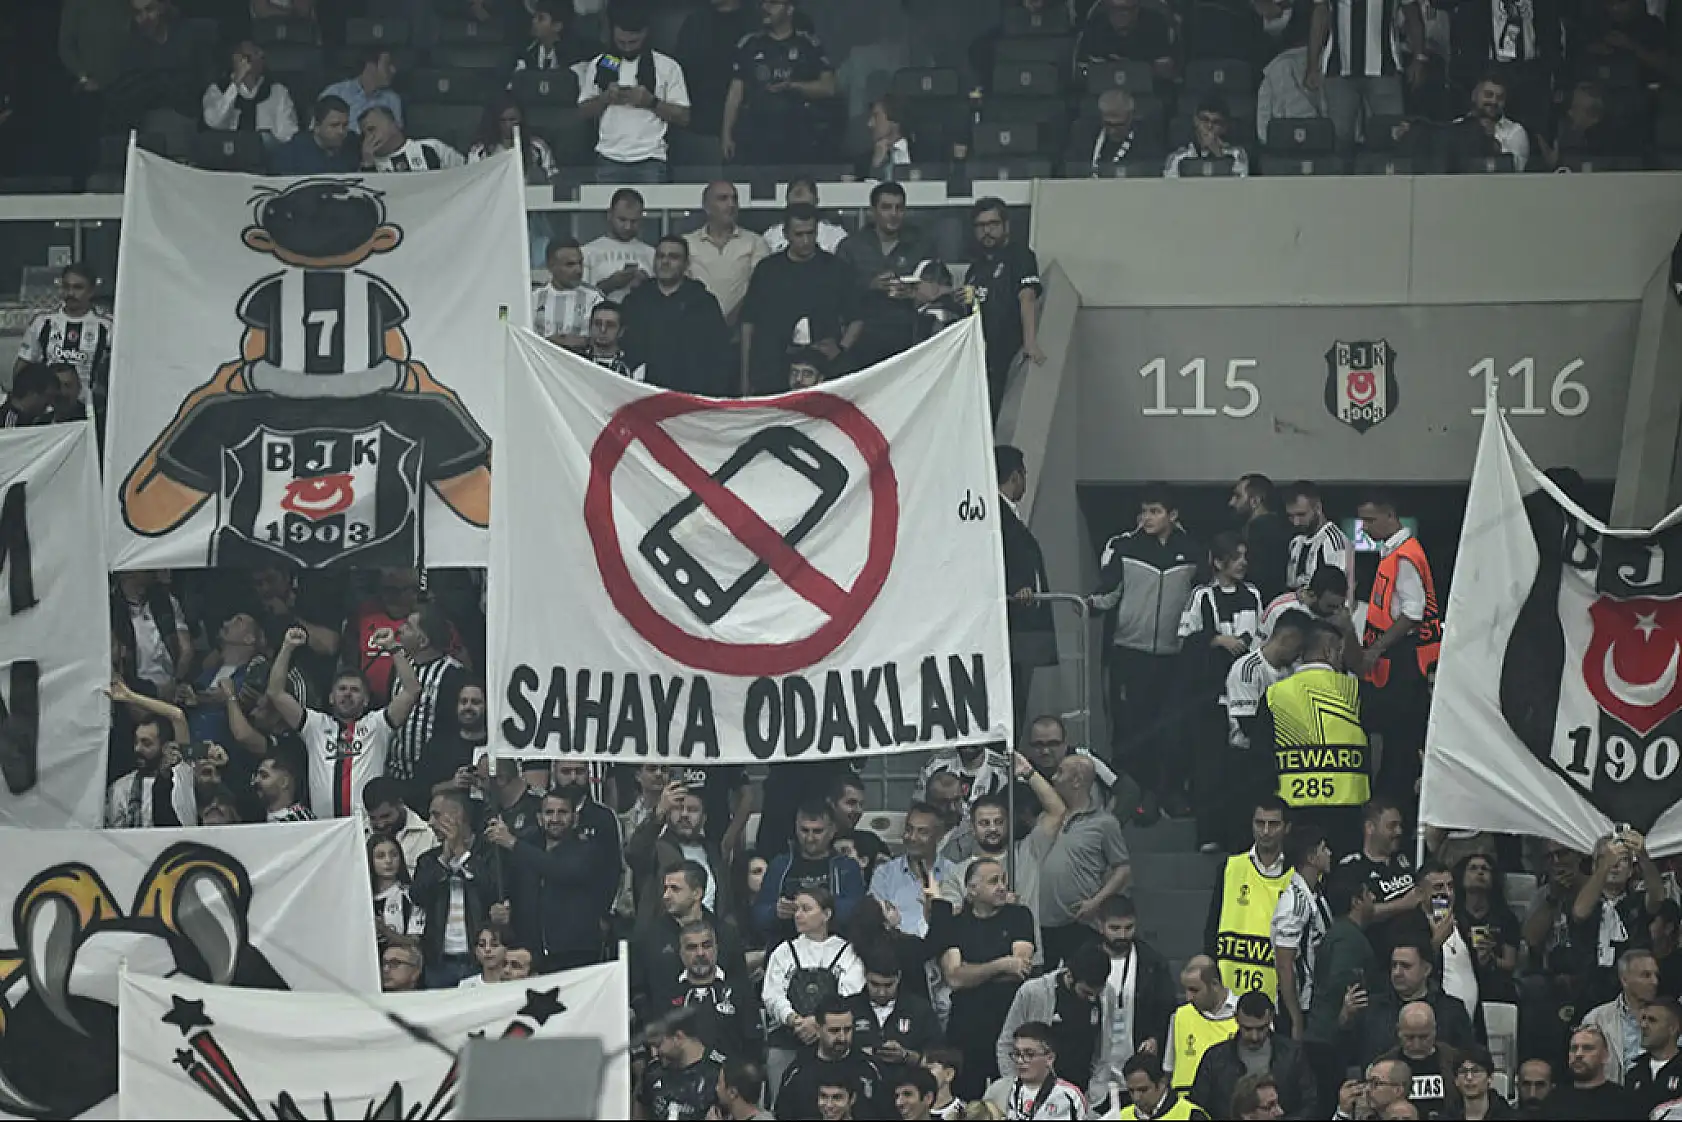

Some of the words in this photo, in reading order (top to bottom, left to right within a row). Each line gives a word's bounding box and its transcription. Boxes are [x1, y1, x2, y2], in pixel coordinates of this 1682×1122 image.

[308, 311, 338, 356] 7
[1140, 357, 1261, 417] 115
[1468, 357, 1590, 416] 116
[265, 521, 371, 544] 1903
[502, 662, 721, 759] SAHAYA
[743, 653, 990, 760] ODAKLAN
[1275, 748, 1363, 769] TEWARD
[1565, 725, 1681, 784] 190
[1291, 778, 1335, 799] 285
[1216, 936, 1275, 963] STEWA
[1234, 968, 1264, 992] 116
